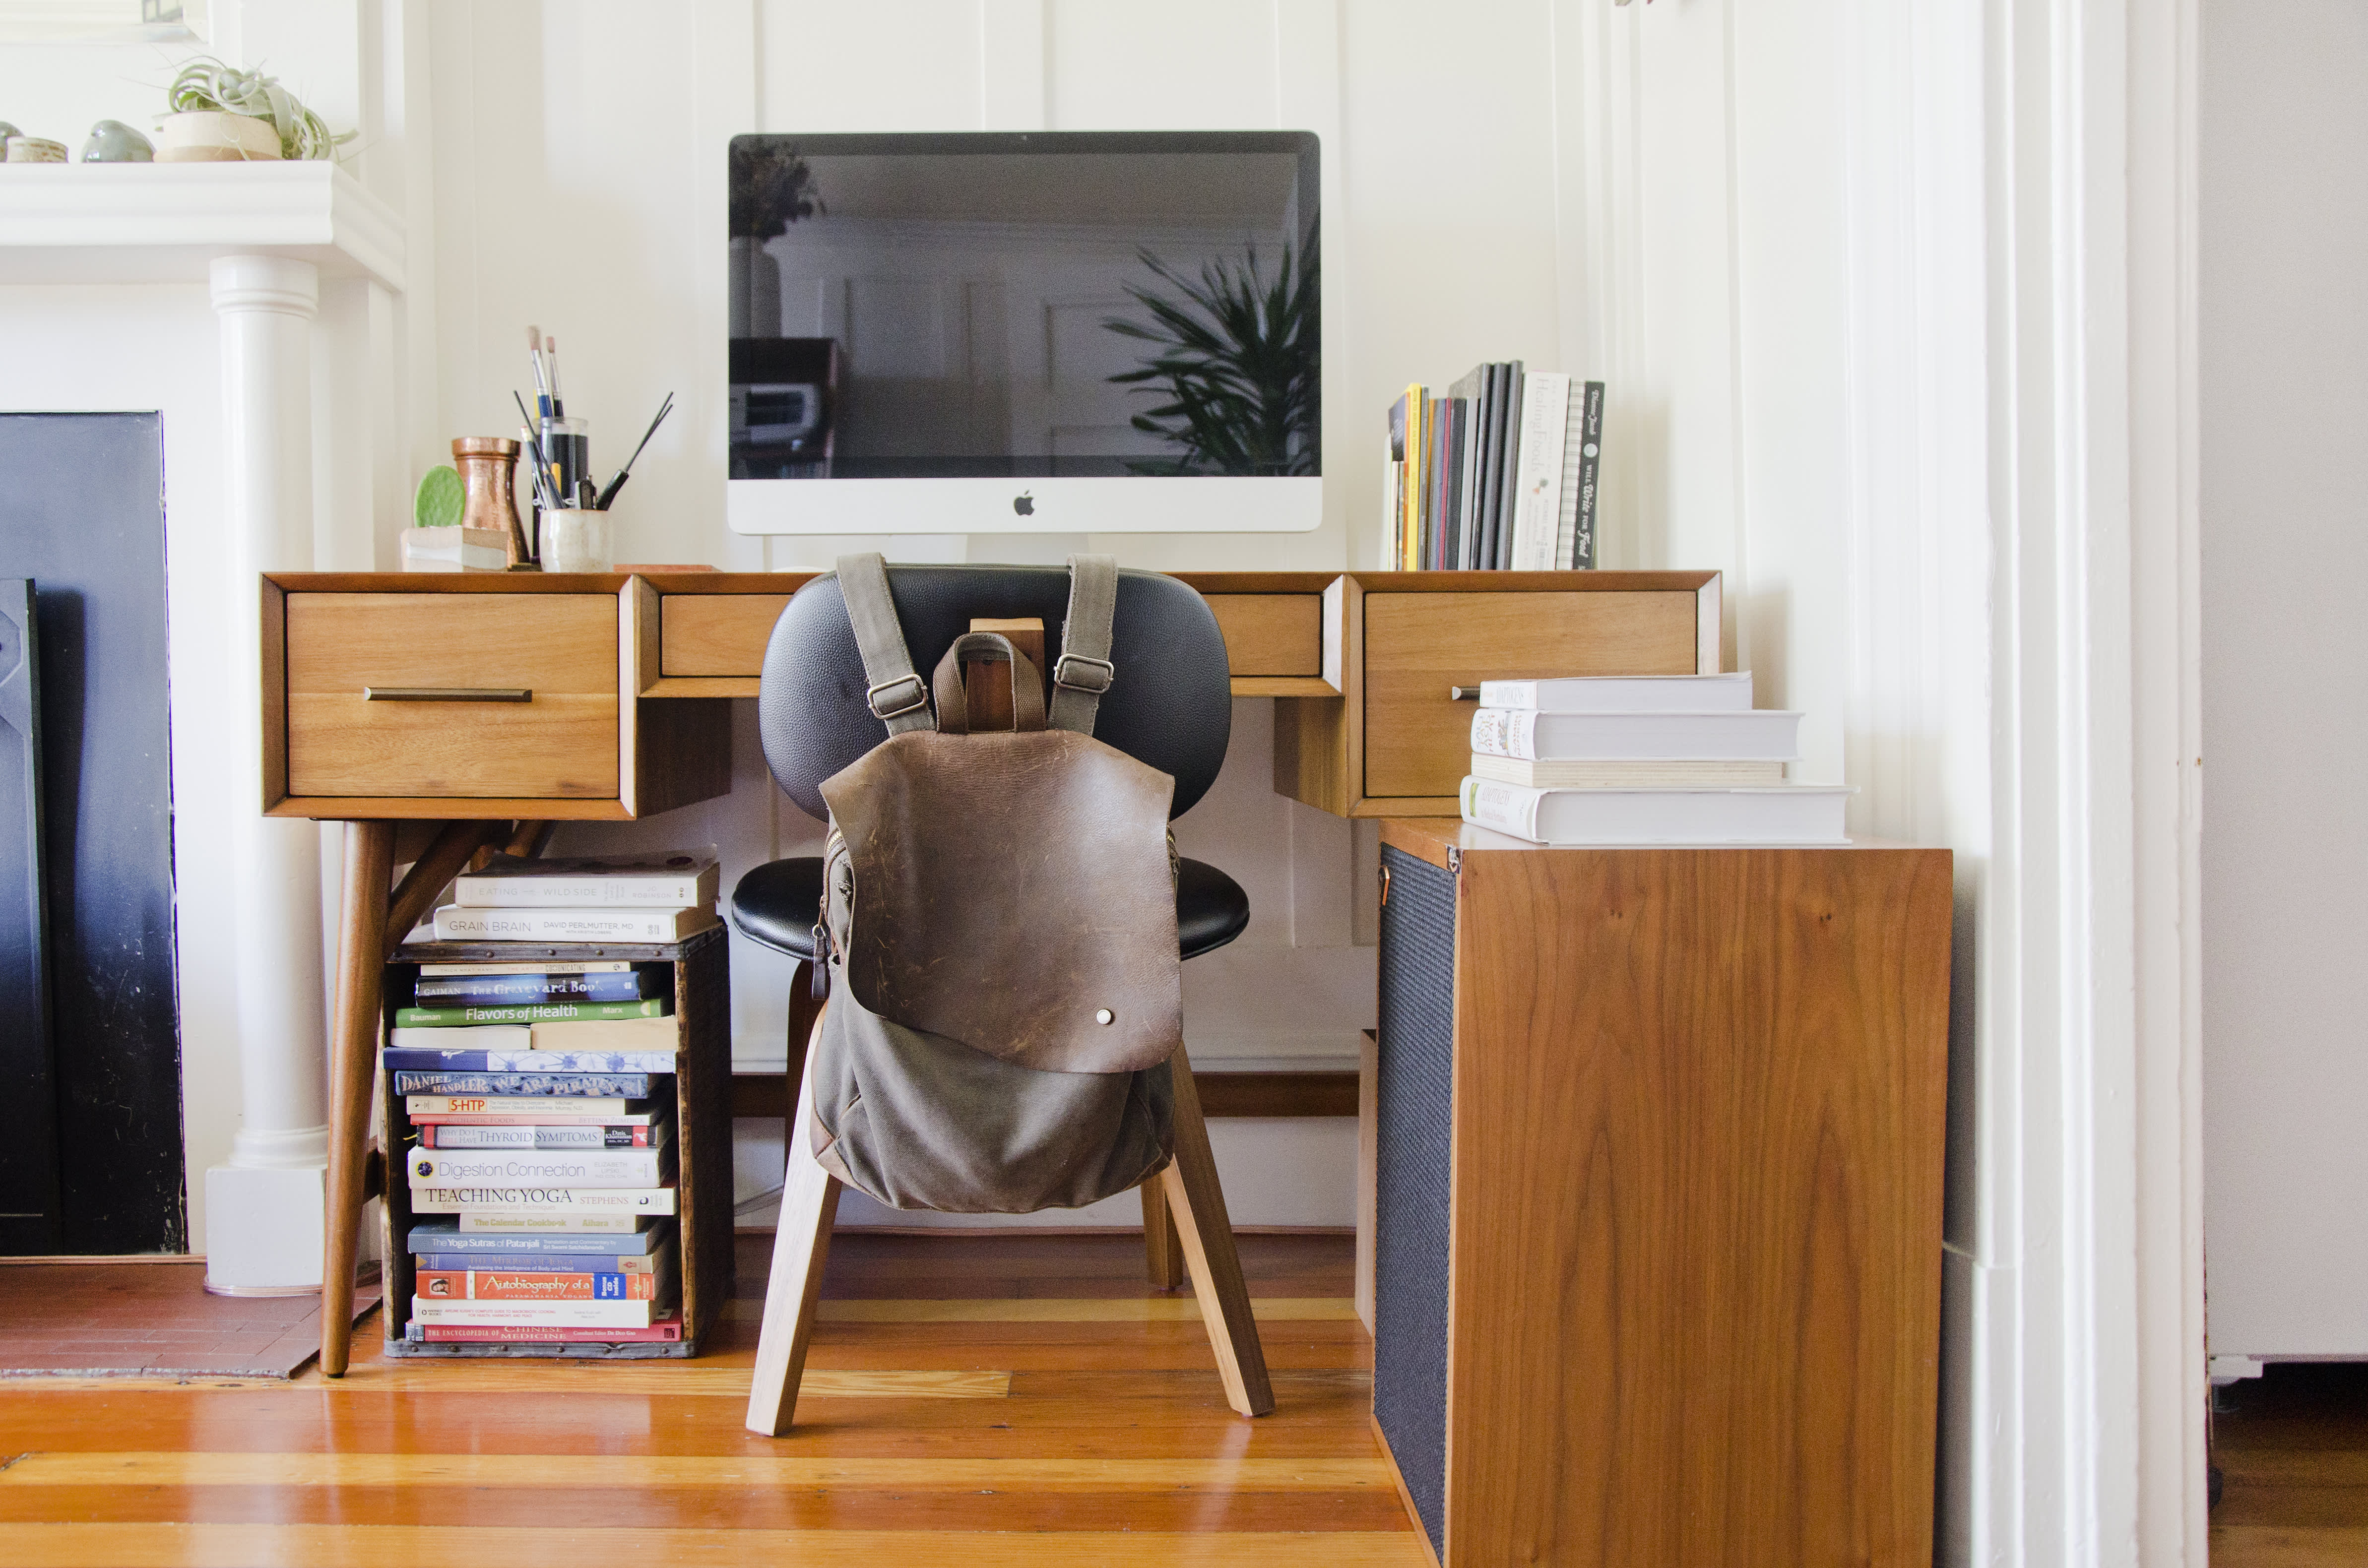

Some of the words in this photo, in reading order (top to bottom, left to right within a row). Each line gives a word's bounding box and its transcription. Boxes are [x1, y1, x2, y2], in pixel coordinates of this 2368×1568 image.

[1530, 378, 1549, 429] Healing
[1532, 431, 1547, 473] Foods
[1582, 484, 1594, 513] Write
[1577, 530, 1591, 558] Food
[449, 921, 489, 931] GRAIN
[492, 921, 531, 932] BRAIN
[569, 922, 620, 930] PERLMUTTER,
[494, 980, 567, 999] Graveyard
[571, 981, 604, 992] Book
[466, 1008, 514, 1020] Flavors
[516, 1008, 530, 1021] of
[533, 1004, 577, 1018] Health
[401, 1075, 451, 1091] DANIEL
[496, 1076, 520, 1089] WE
[523, 1076, 550, 1093] ARE
[553, 1077, 618, 1095] PIRATES
[450, 1099, 485, 1112] 5-HTP
[477, 1131, 532, 1142] THYROID
[535, 1131, 603, 1143] SYMPTOMS?
[439, 1162, 503, 1180] Digestion
[507, 1162, 586, 1177] Connection
[425, 1188, 516, 1202] TEACHING
[520, 1189, 573, 1203] YOGA
[580, 1196, 629, 1205] STEPHENS
[521, 1203, 556, 1212] Techniques
[474, 1218, 489, 1227] The
[490, 1218, 525, 1227] Calendar
[527, 1218, 567, 1227] Cookbook
[432, 1238, 447, 1247] The
[448, 1239, 468, 1249] Yoga
[469, 1239, 496, 1248] Sutras
[506, 1239, 540, 1250] Patanjali
[468, 1255, 486, 1265] THE
[492, 1255, 530, 1265] MIRROR
[483, 1276, 569, 1296] Autobiography
[572, 1279, 584, 1290] of
[607, 1282, 613, 1291] CD
